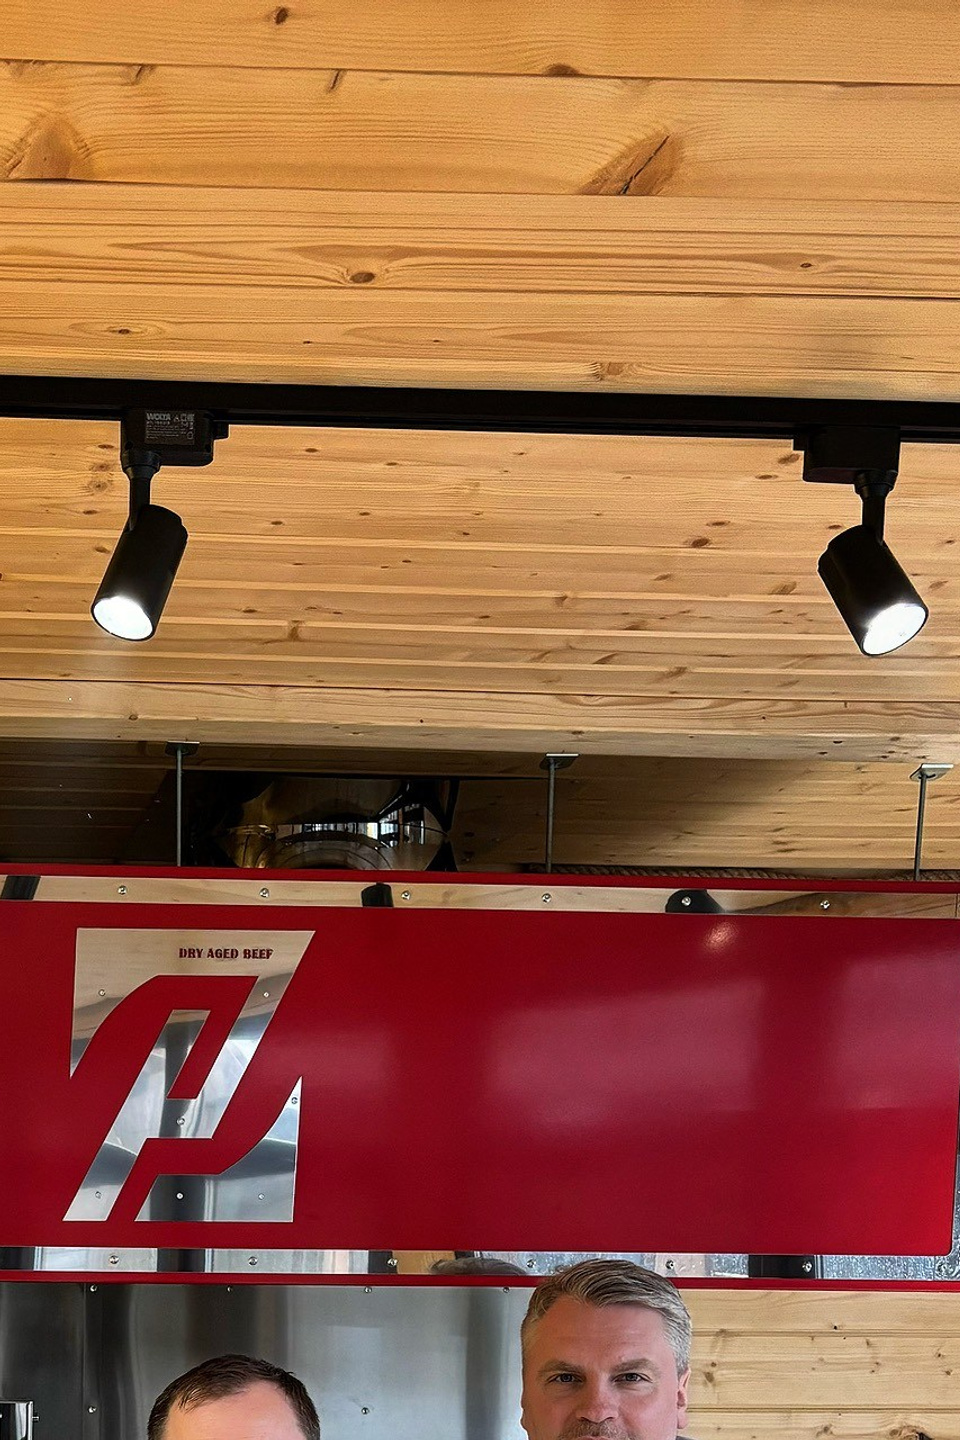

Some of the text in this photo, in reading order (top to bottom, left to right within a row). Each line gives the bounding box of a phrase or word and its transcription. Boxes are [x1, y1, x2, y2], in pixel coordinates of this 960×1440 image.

[179, 948, 274, 960] DRY AGED BEEF
